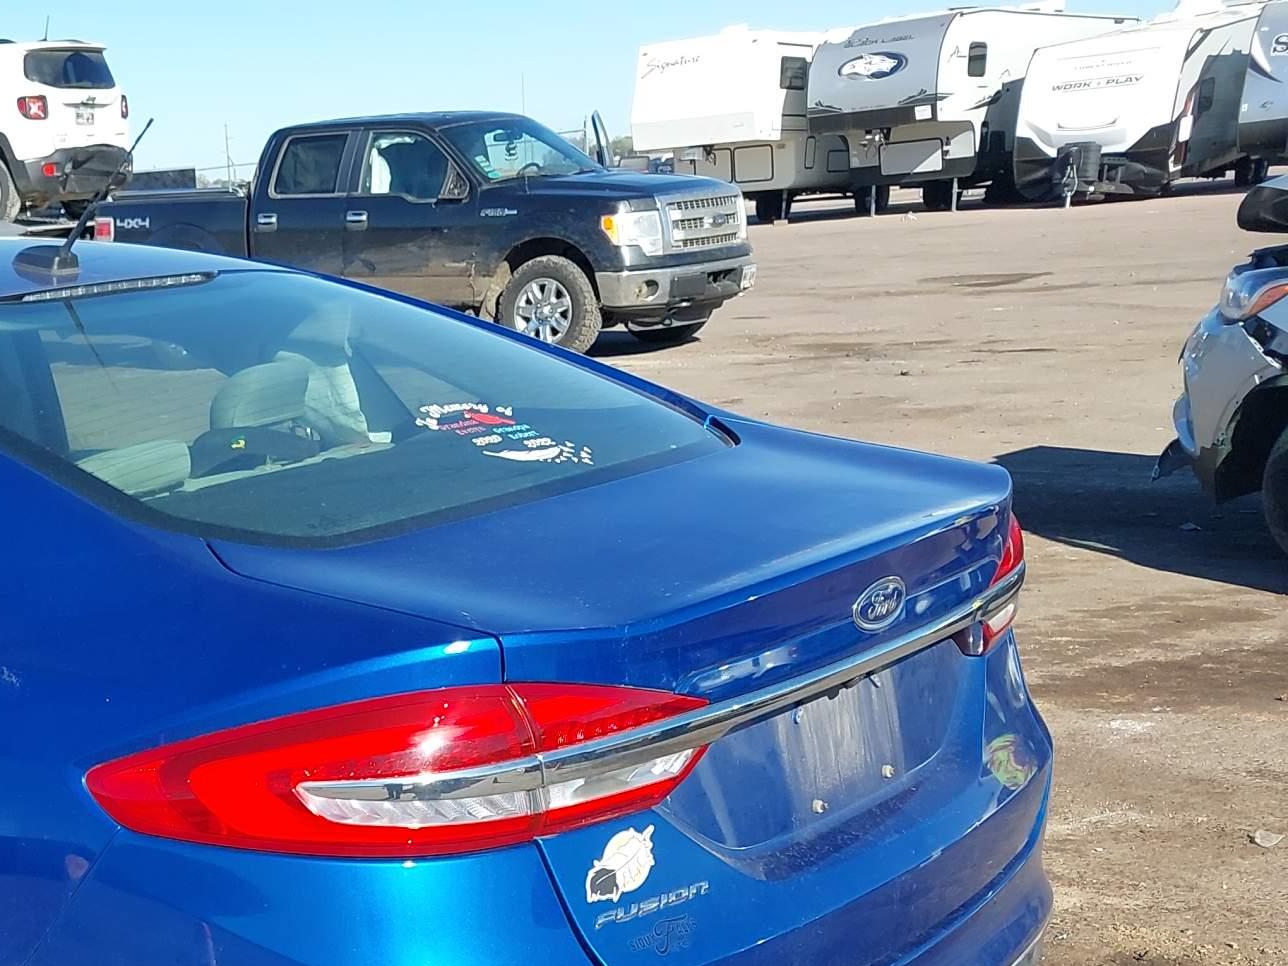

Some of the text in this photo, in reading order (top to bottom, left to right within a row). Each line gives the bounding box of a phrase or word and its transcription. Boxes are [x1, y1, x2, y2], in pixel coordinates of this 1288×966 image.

[1051, 73, 1145, 92] WORK PLAY
[866, 585, 898, 619] Ford
